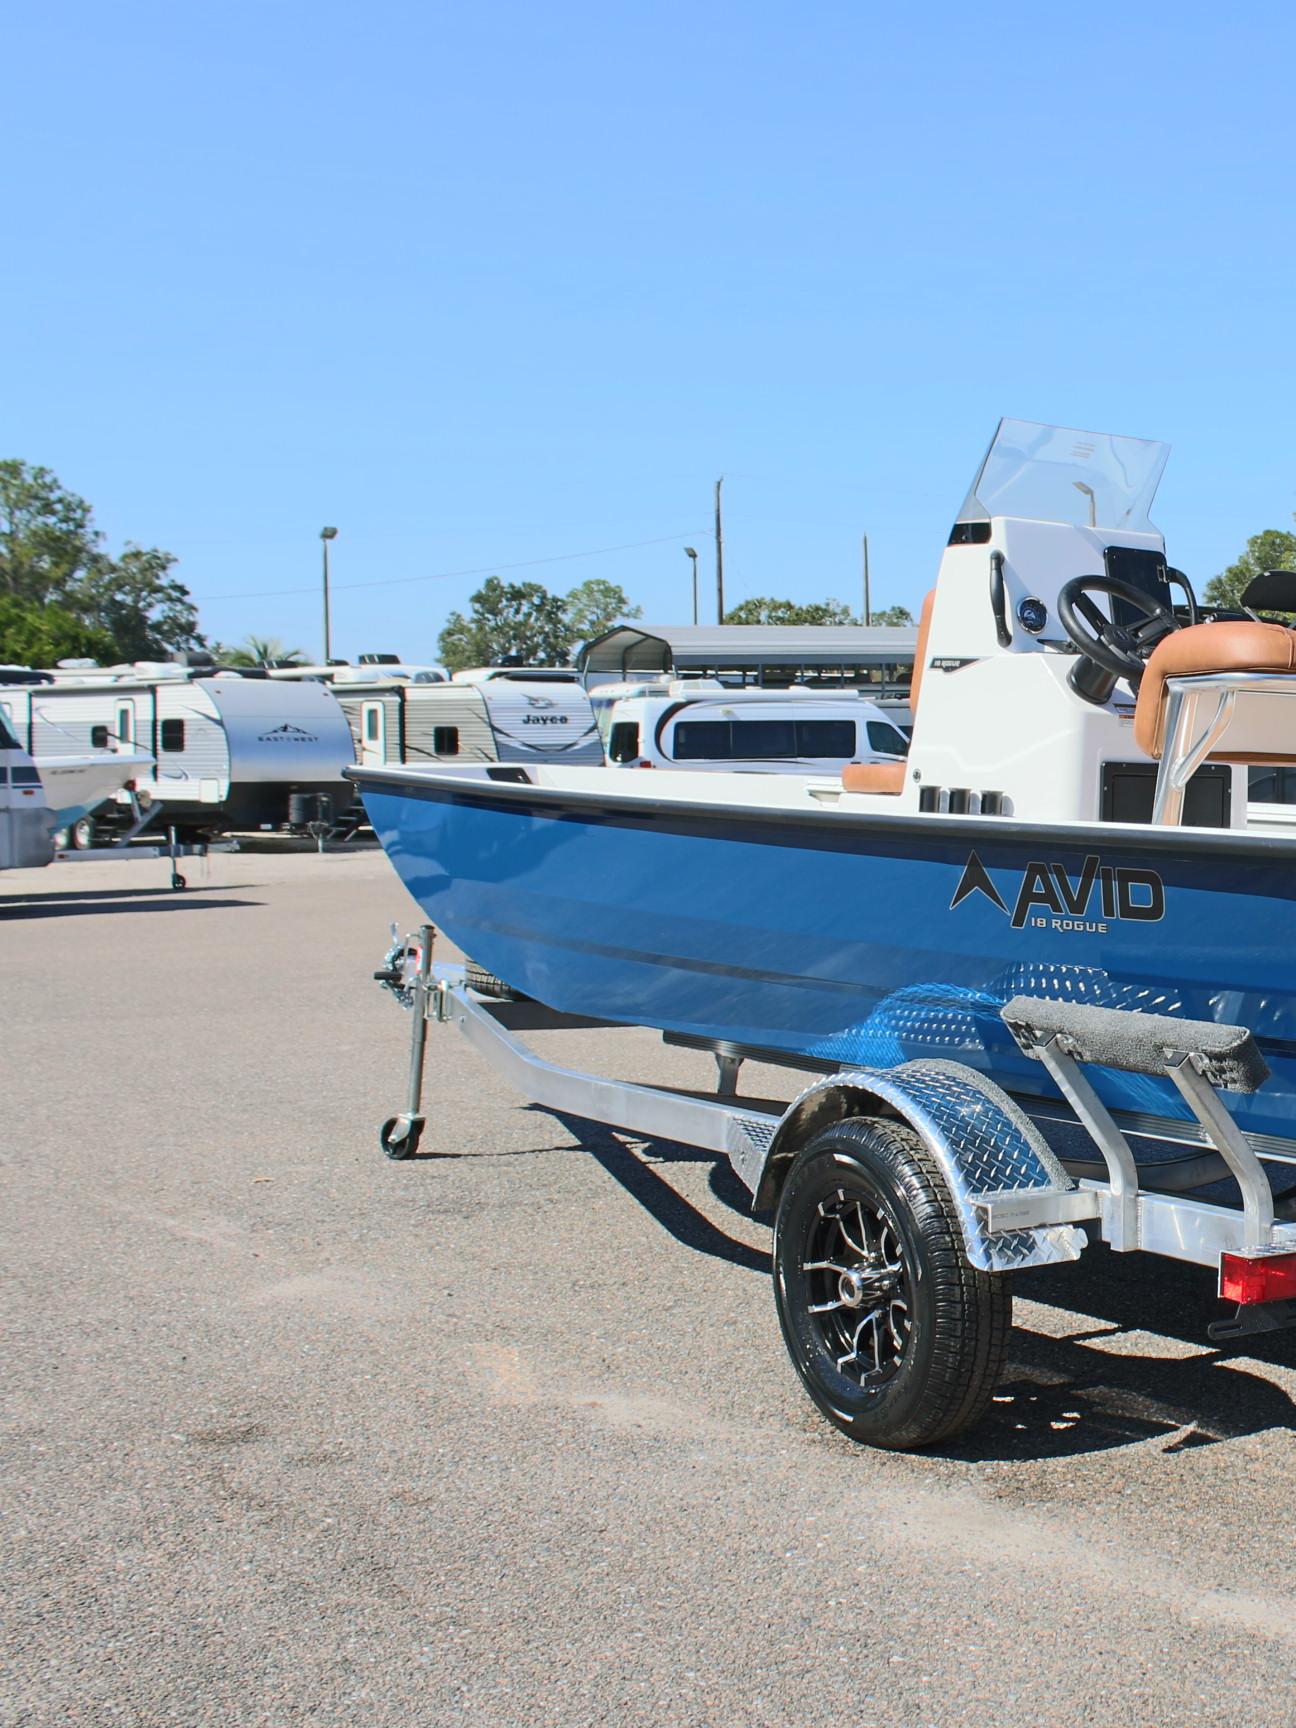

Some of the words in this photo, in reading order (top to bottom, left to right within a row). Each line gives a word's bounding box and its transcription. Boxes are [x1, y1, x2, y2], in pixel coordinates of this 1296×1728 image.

[522, 714, 568, 726] Jayco
[1010, 854, 1166, 929] AVID
[1052, 918, 1109, 933] ROGUE
